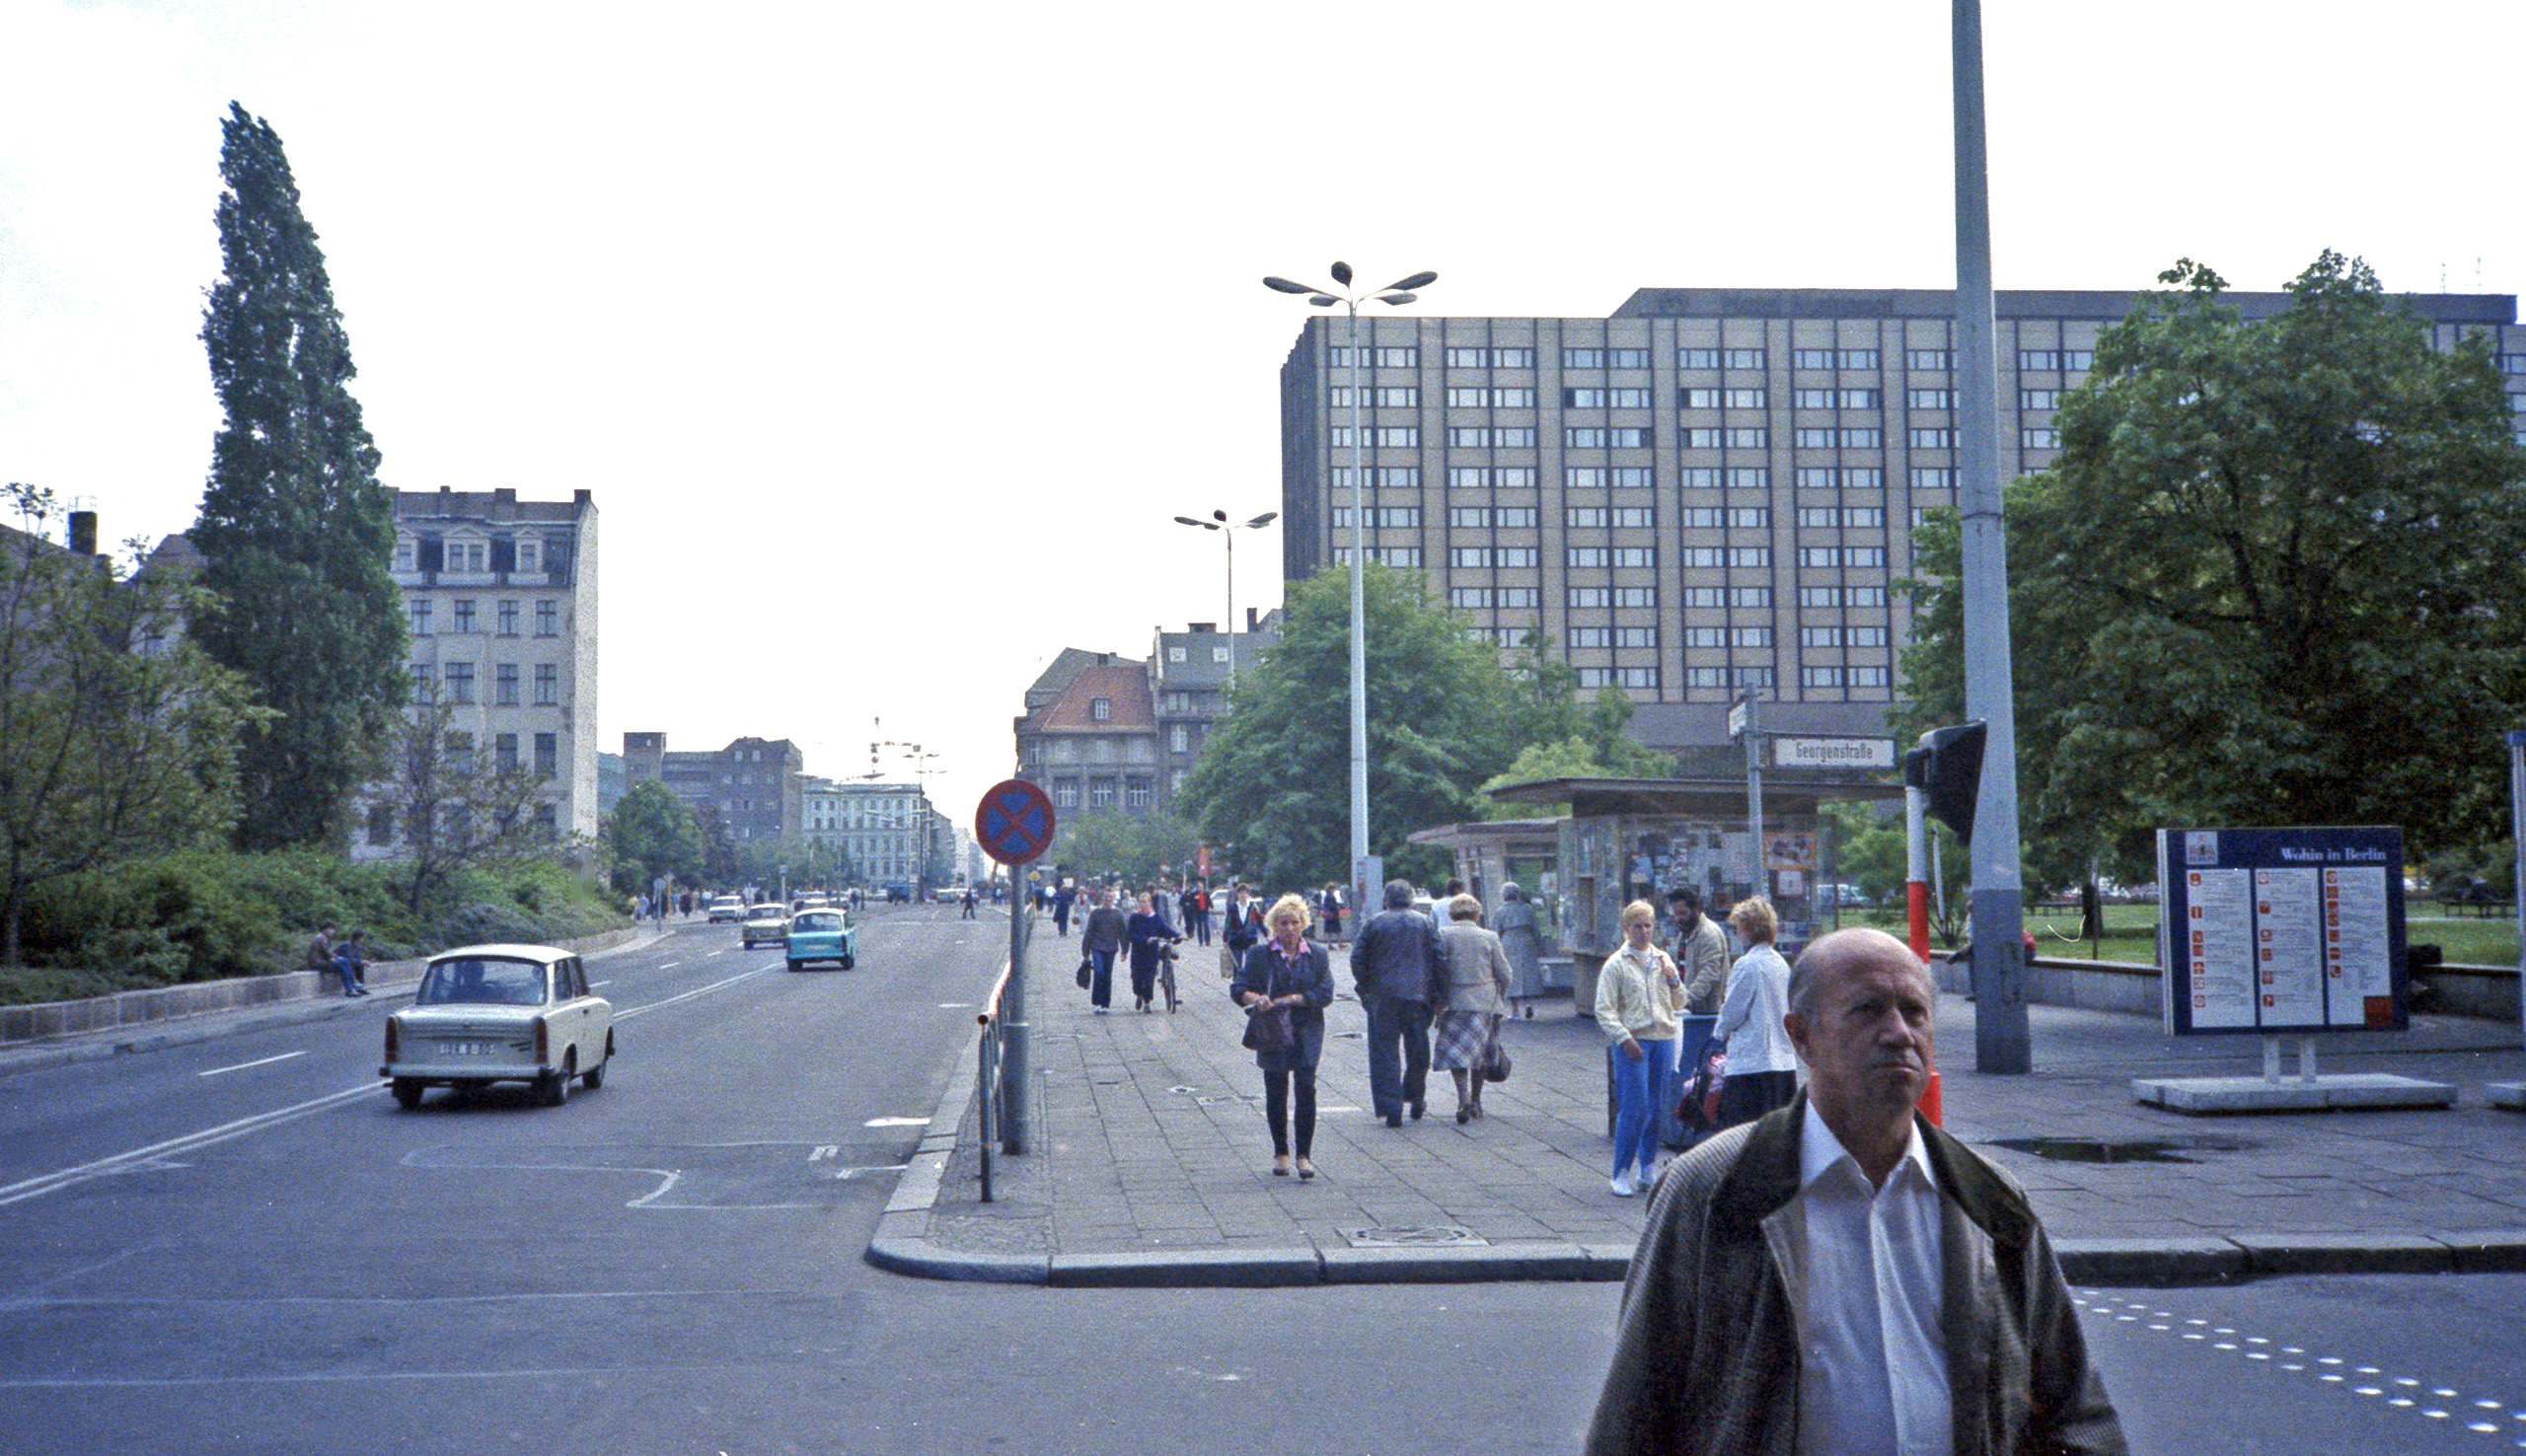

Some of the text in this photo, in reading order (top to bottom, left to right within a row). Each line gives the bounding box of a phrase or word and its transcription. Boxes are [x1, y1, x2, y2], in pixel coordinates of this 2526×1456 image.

[1796, 743, 1873, 763] Georgenstraße
[2281, 847, 2386, 861] Wohin in Berlin
